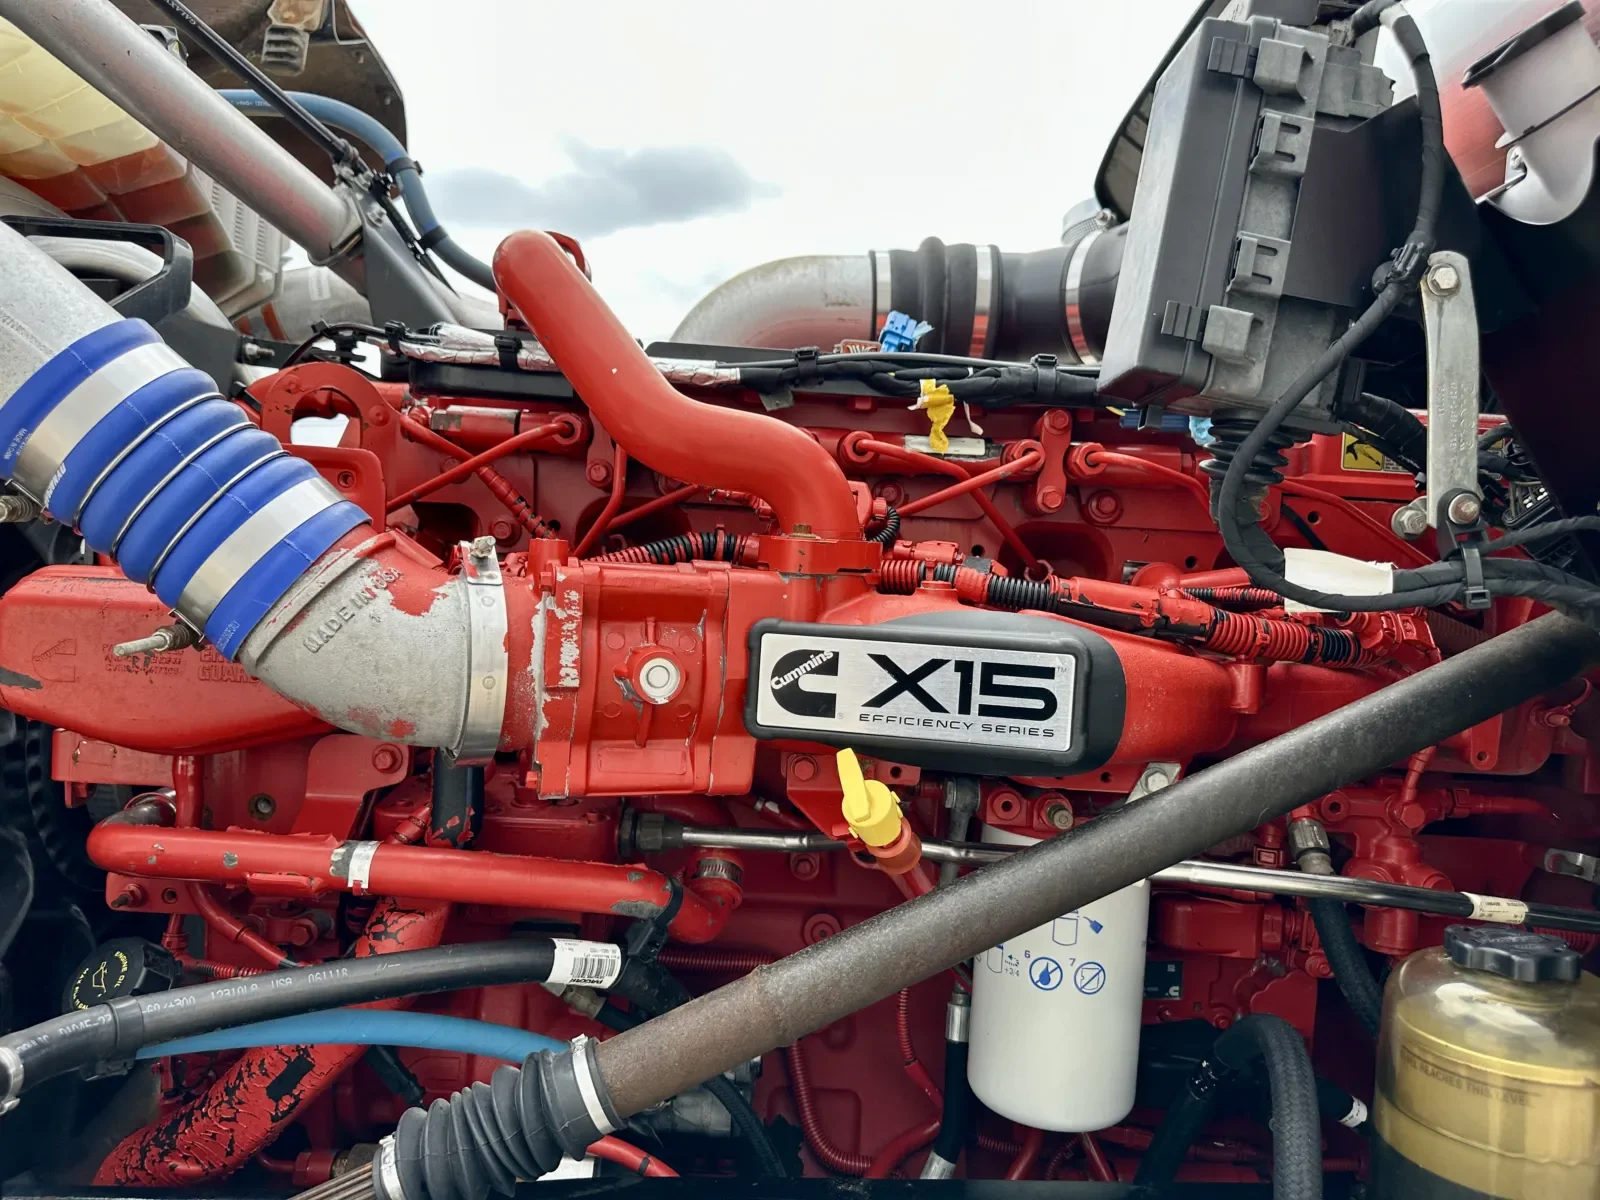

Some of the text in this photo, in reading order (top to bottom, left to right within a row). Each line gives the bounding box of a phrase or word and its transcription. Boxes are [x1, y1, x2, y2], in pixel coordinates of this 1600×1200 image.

[303, 606, 356, 654] MADE
[770, 650, 835, 691] Cummins
[861, 652, 1058, 722] X15
[859, 712, 1055, 738] EFFICIENCY SERIES
[113, 950, 128, 989] ENGINE OIL
[1024, 950, 1031, 959] 6
[1068, 957, 1077, 967] 7
